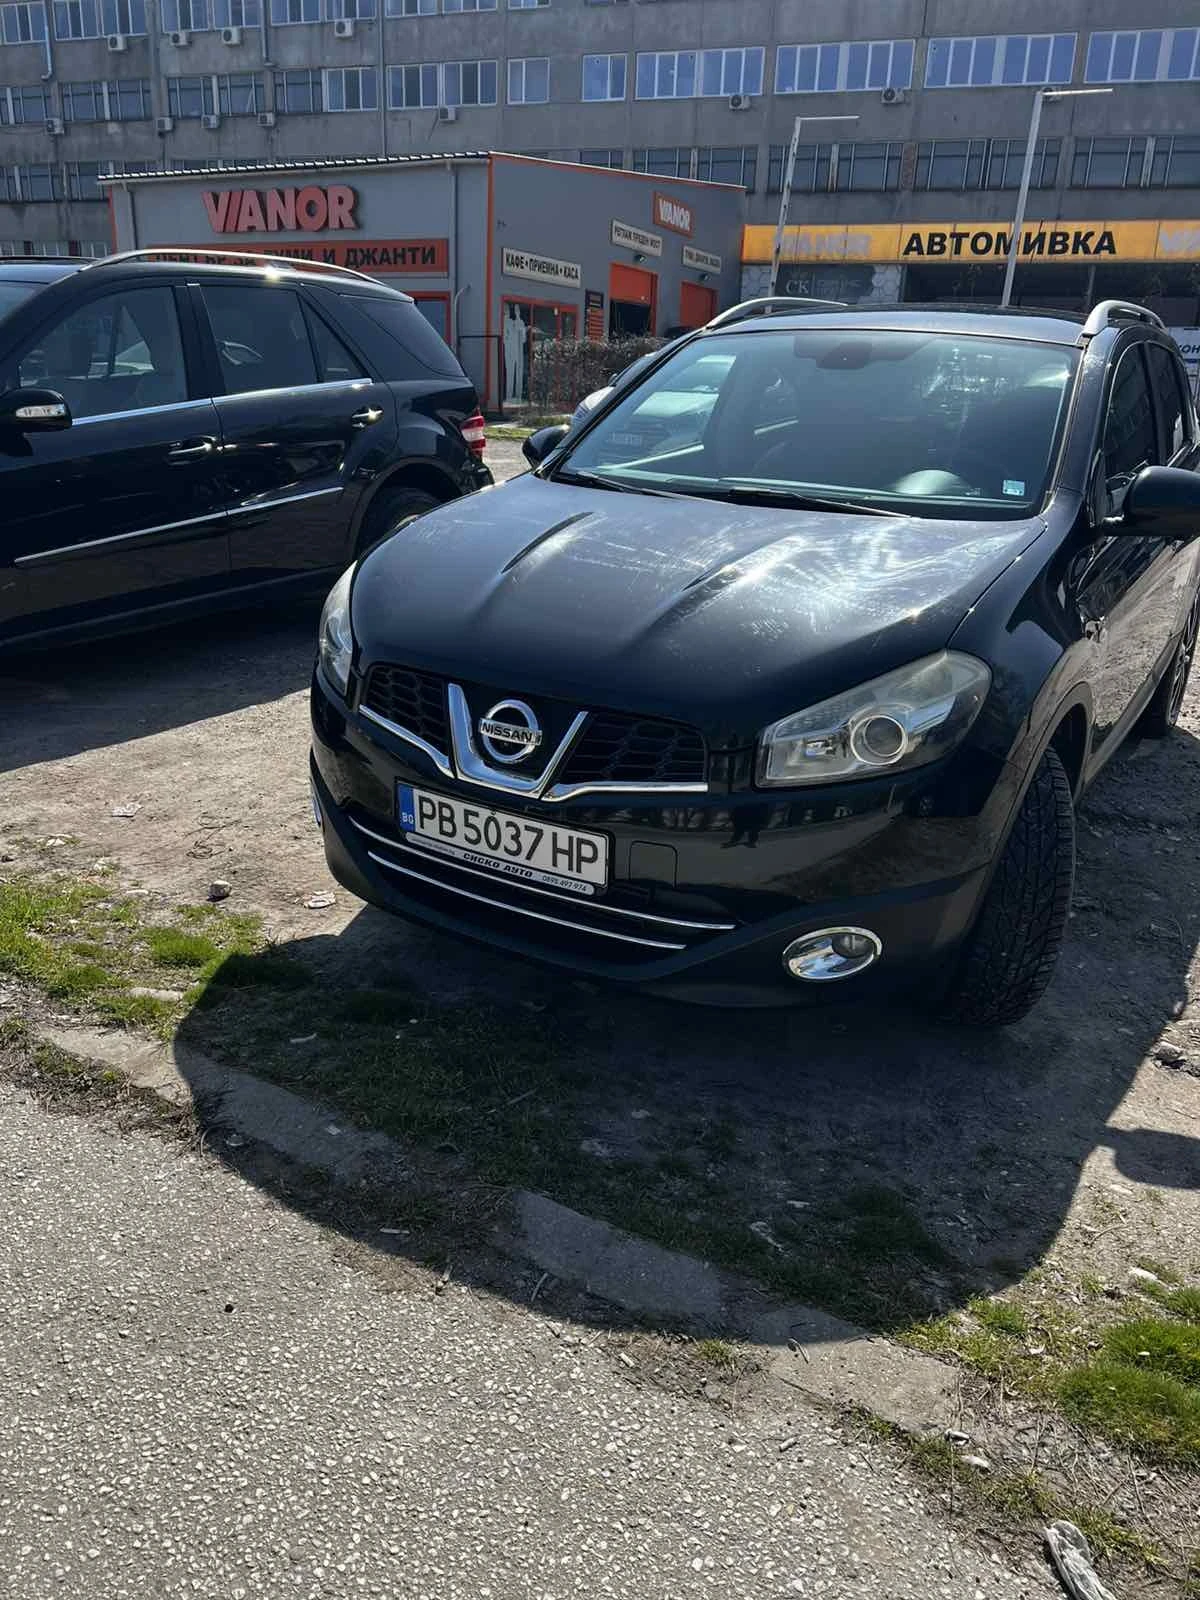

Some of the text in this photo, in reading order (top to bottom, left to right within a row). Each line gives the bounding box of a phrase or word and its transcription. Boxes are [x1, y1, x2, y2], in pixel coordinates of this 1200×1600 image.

[203, 184, 358, 233] VIANOR
[903, 231, 1116, 255] АВТОМИВКА
[322, 249, 336, 265] И
[344, 246, 435, 268] ДЖАНТИ
[505, 254, 524, 269] КАФЕ
[564, 265, 578, 279] КАСА
[482, 722, 532, 743] NISSAN
[463, 808, 544, 861] 5037
